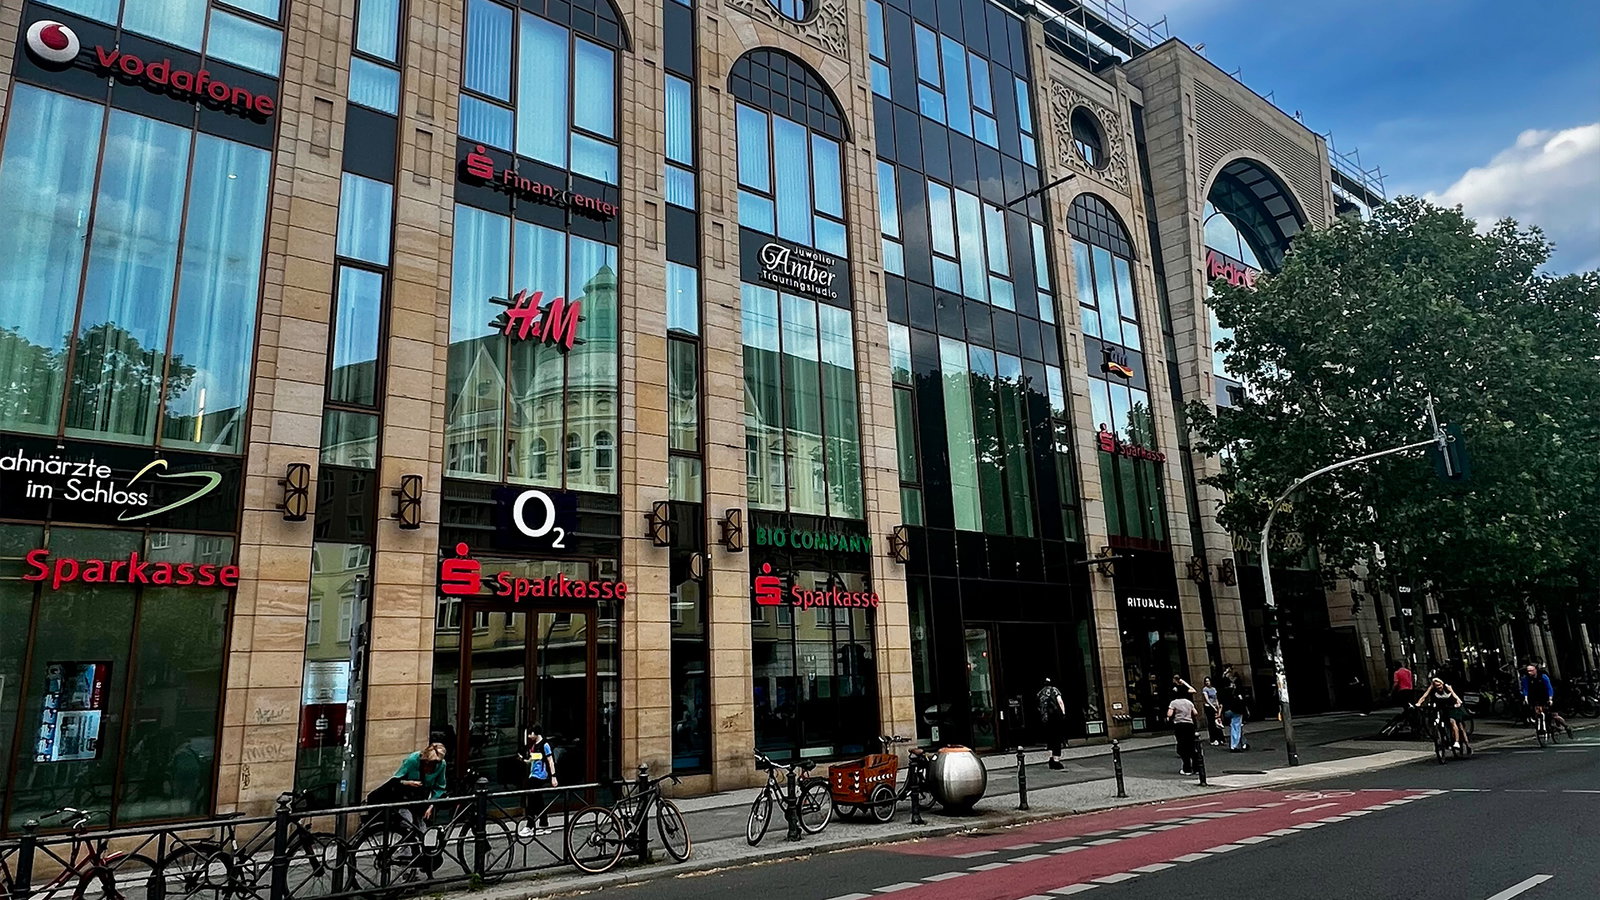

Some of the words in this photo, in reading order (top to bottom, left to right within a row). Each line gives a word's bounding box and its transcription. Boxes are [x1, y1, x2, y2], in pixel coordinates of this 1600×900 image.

[95, 45, 276, 115] vodafone
[761, 242, 836, 287] Amber
[505, 288, 582, 350] H&M
[26, 480, 53, 499] im
[63, 478, 149, 506] Schloss
[756, 527, 787, 548] BIO
[790, 530, 872, 553] COMPANY
[22, 549, 240, 591] Sparkasse
[496, 571, 629, 603] Sparkasse
[791, 584, 880, 612] Sparkasse
